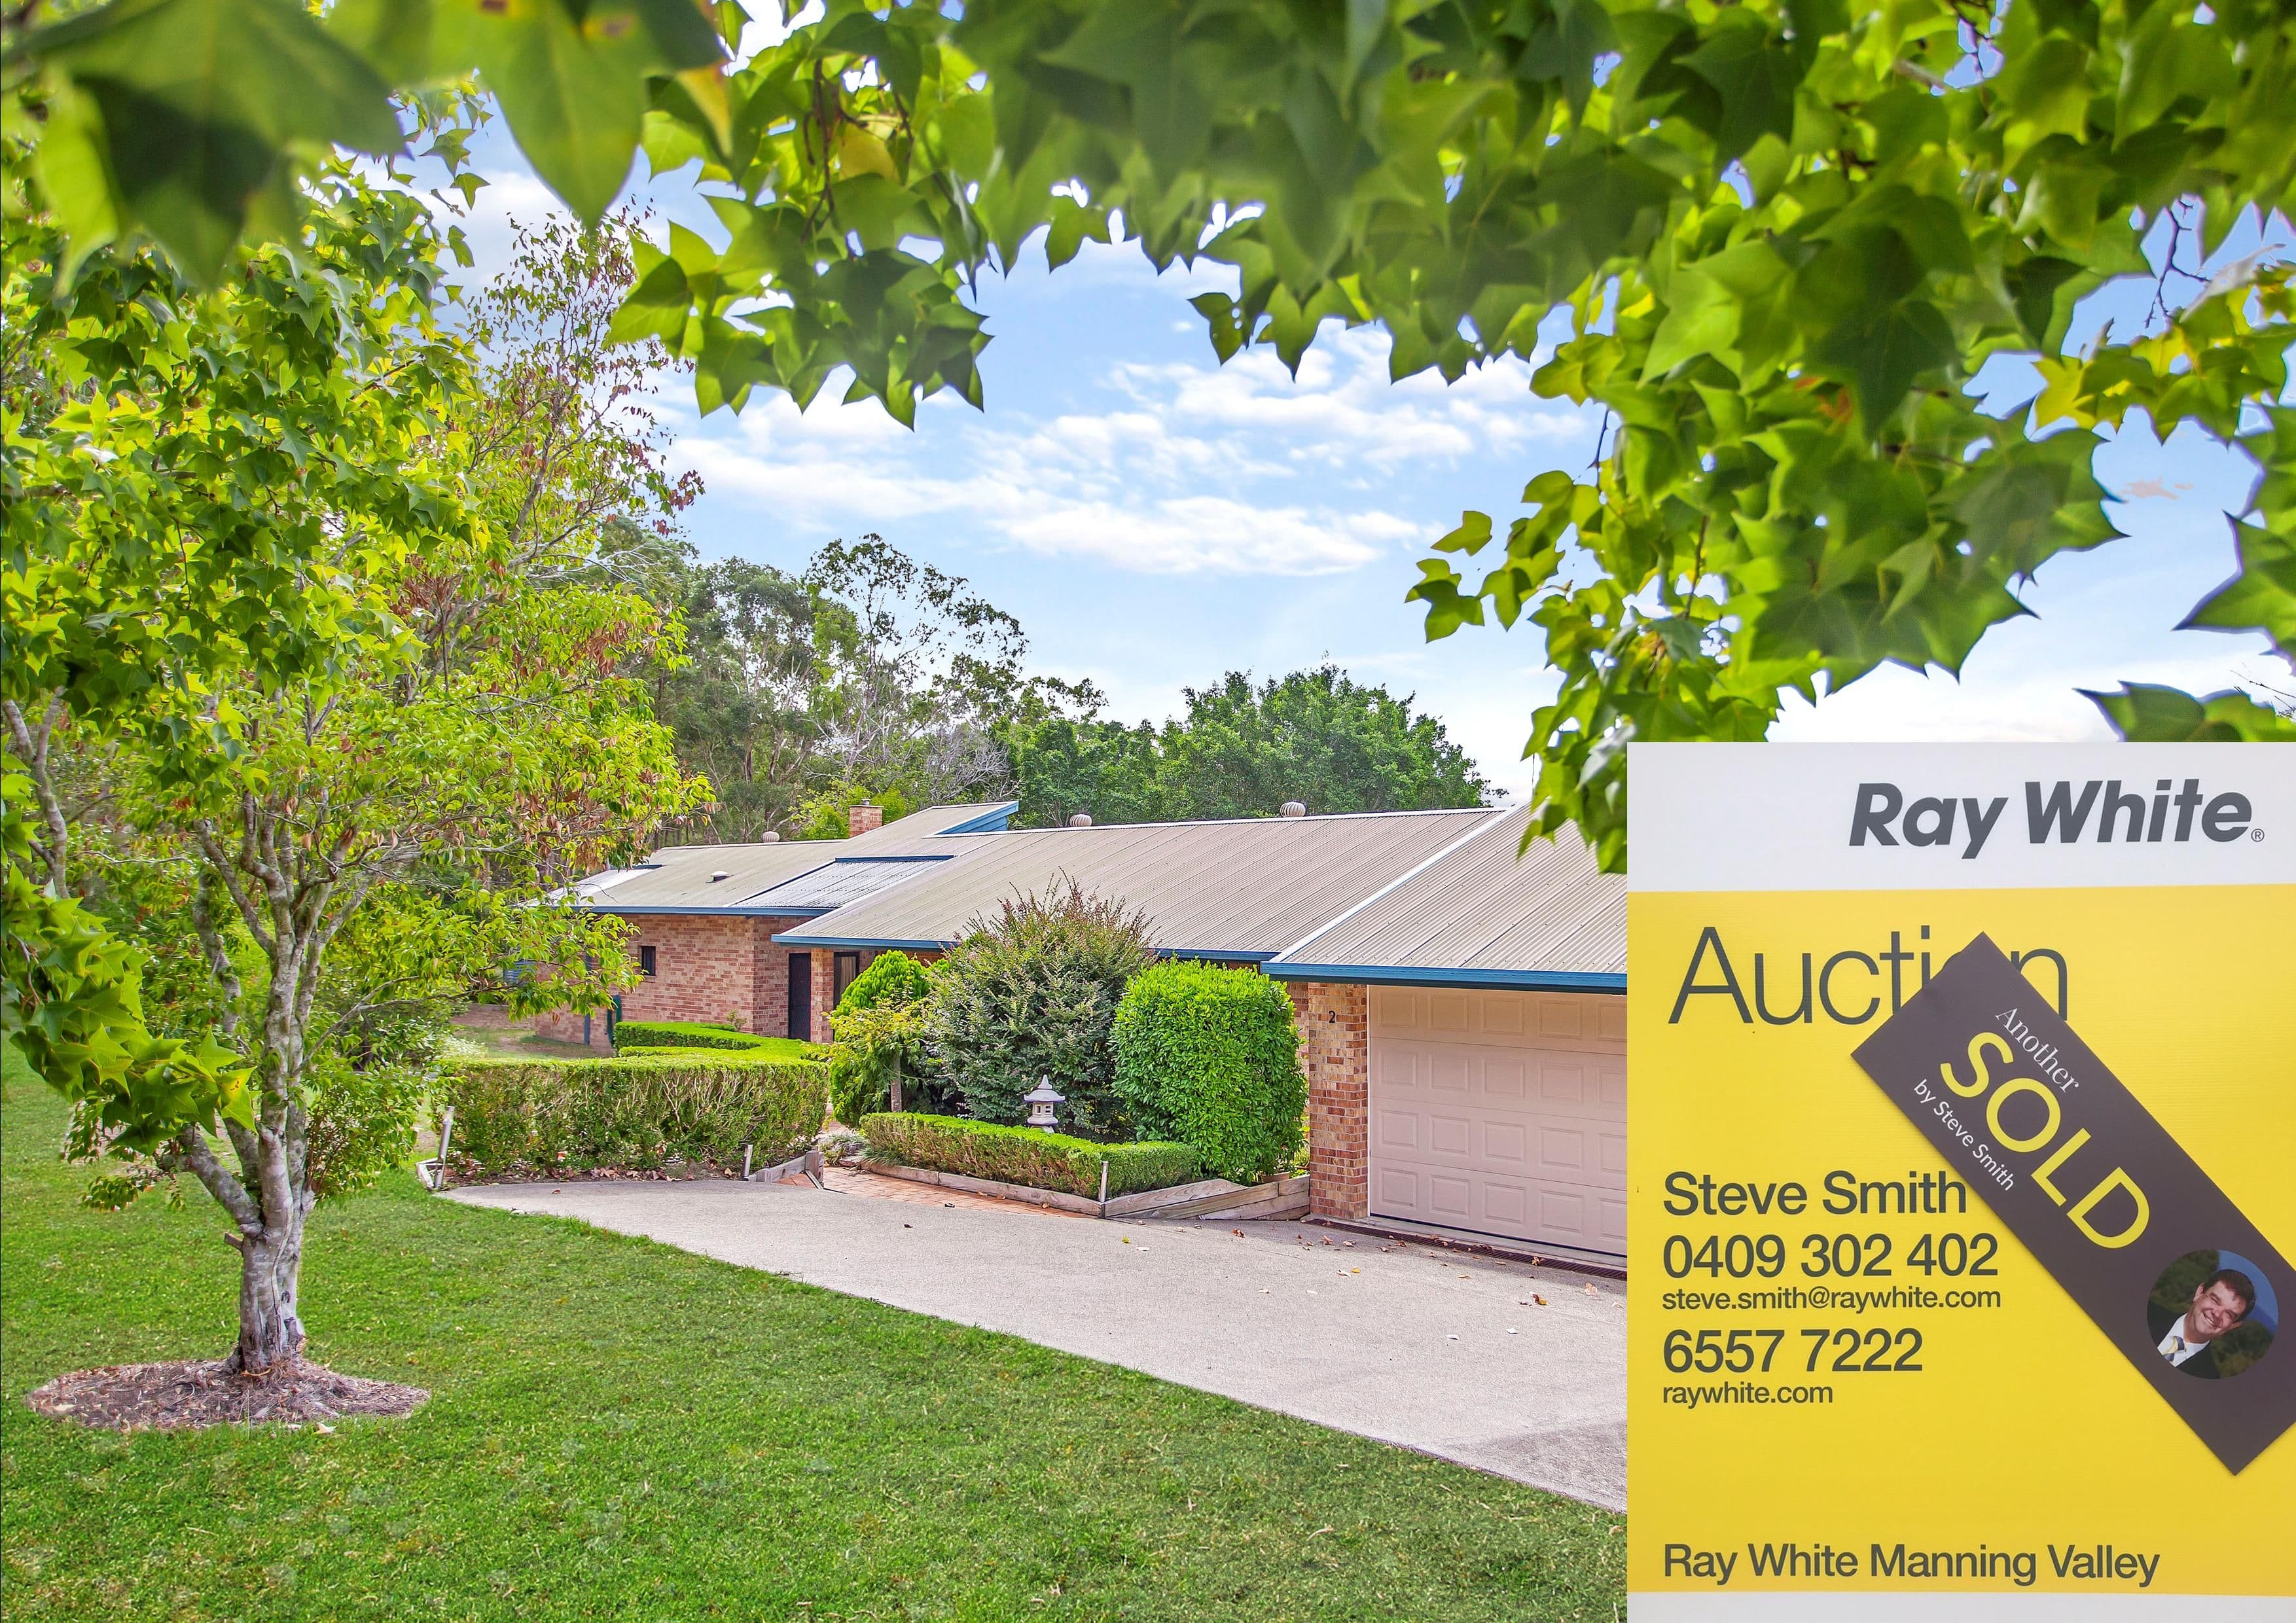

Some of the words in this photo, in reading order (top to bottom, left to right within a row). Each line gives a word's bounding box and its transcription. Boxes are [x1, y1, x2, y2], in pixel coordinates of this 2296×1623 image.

[1849, 783, 2007, 859] Ray
[1668, 925, 2068, 1026] Auctin
[1329, 1010, 1336, 1024] 2
[1994, 1007, 2080, 1094] Another
[1913, 1079, 1937, 1103] by
[1933, 1101, 1974, 1147] Steve
[1972, 1144, 2014, 1191] Smith
[1939, 1031, 2150, 1249] SOLD
[1663, 1171, 1808, 1216] Steve
[1822, 1170, 1967, 1215] Smith
[1663, 1234, 1785, 1279] 0409
[1801, 1233, 1892, 1277] 302
[1907, 1232, 1998, 1277] 402
[1662, 1285, 2001, 1314] steve.smith@raywhite.com
[1663, 1329, 1785, 1373] 6557
[1801, 1327, 1923, 1372] 7222
[1663, 1381, 1833, 1410] raywhite.com
[1664, 1543, 1738, 1586] Ray
[1748, 1543, 1858, 1577] White
[1871, 1543, 2036, 1586] Manning
[2047, 1544, 2161, 1588] Valley
